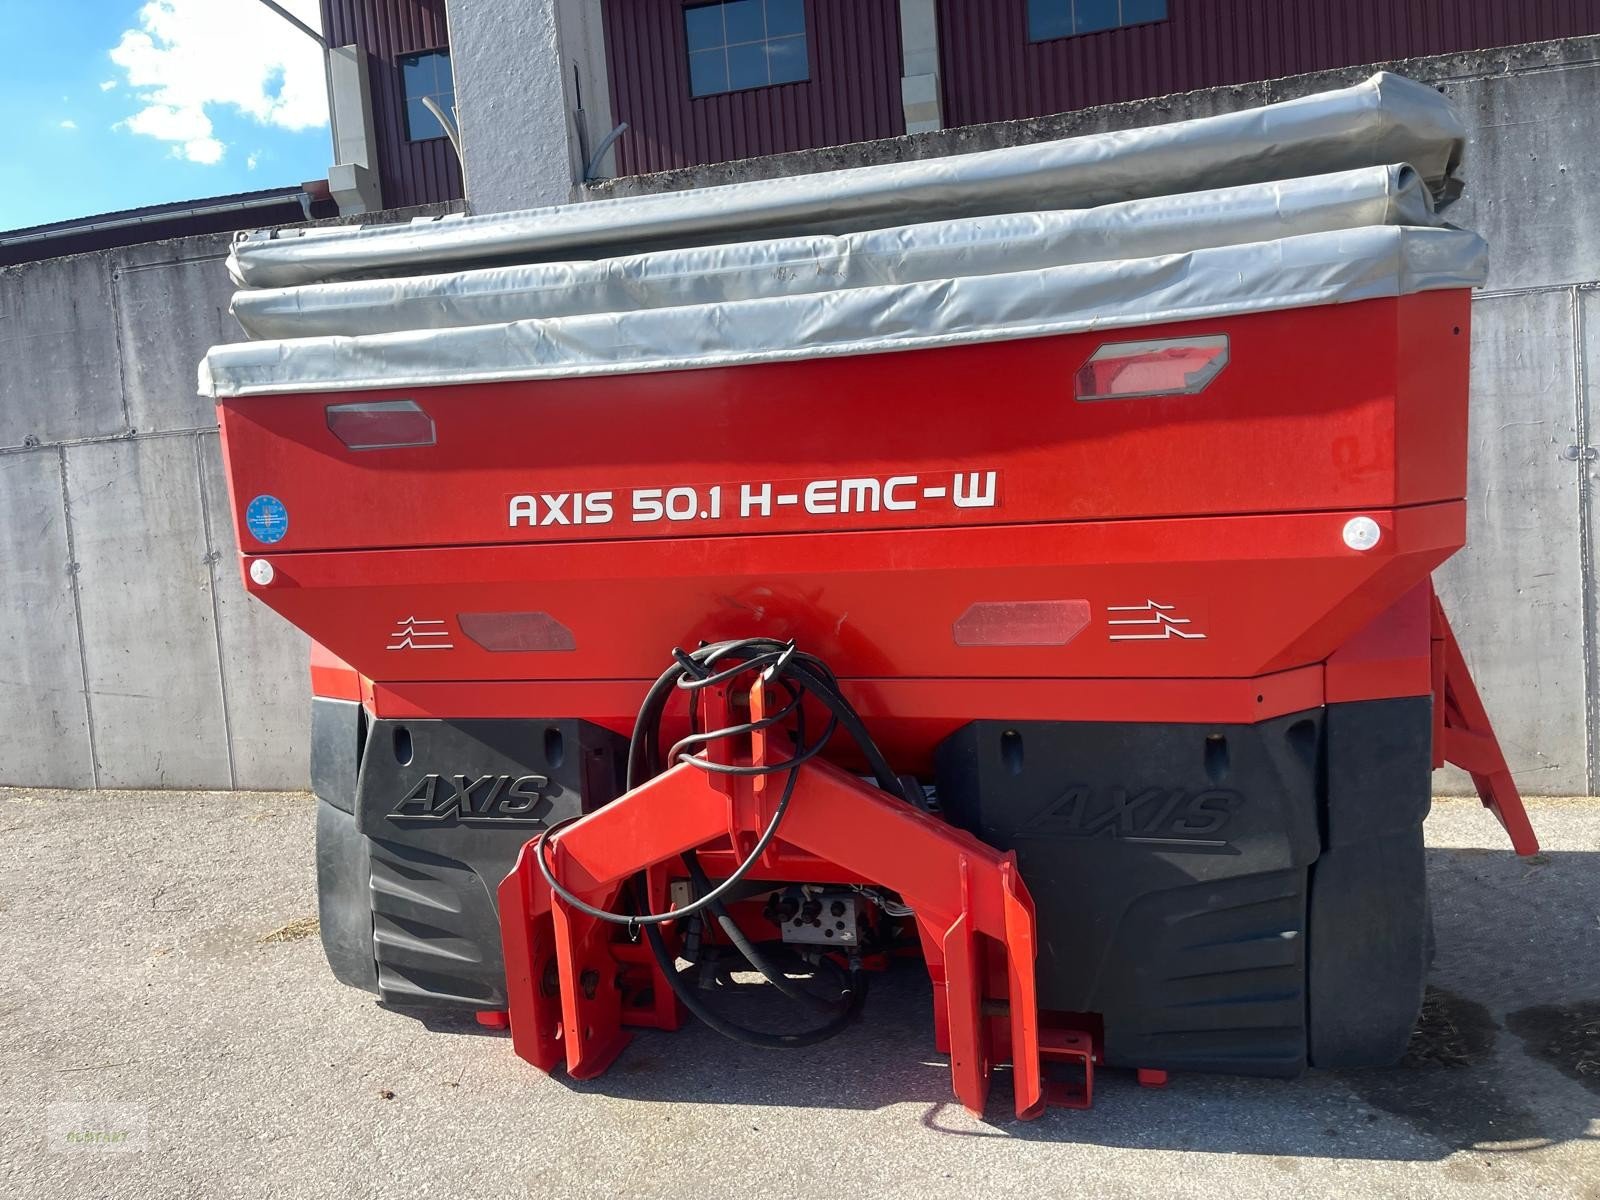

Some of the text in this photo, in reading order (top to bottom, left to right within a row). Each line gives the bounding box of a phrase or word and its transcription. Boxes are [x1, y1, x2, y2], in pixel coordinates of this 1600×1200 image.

[508, 471, 997, 527] AXIS 50.1 H-EMC-W
[391, 774, 548, 815] AXIS
[1023, 785, 1241, 835] AXIS
